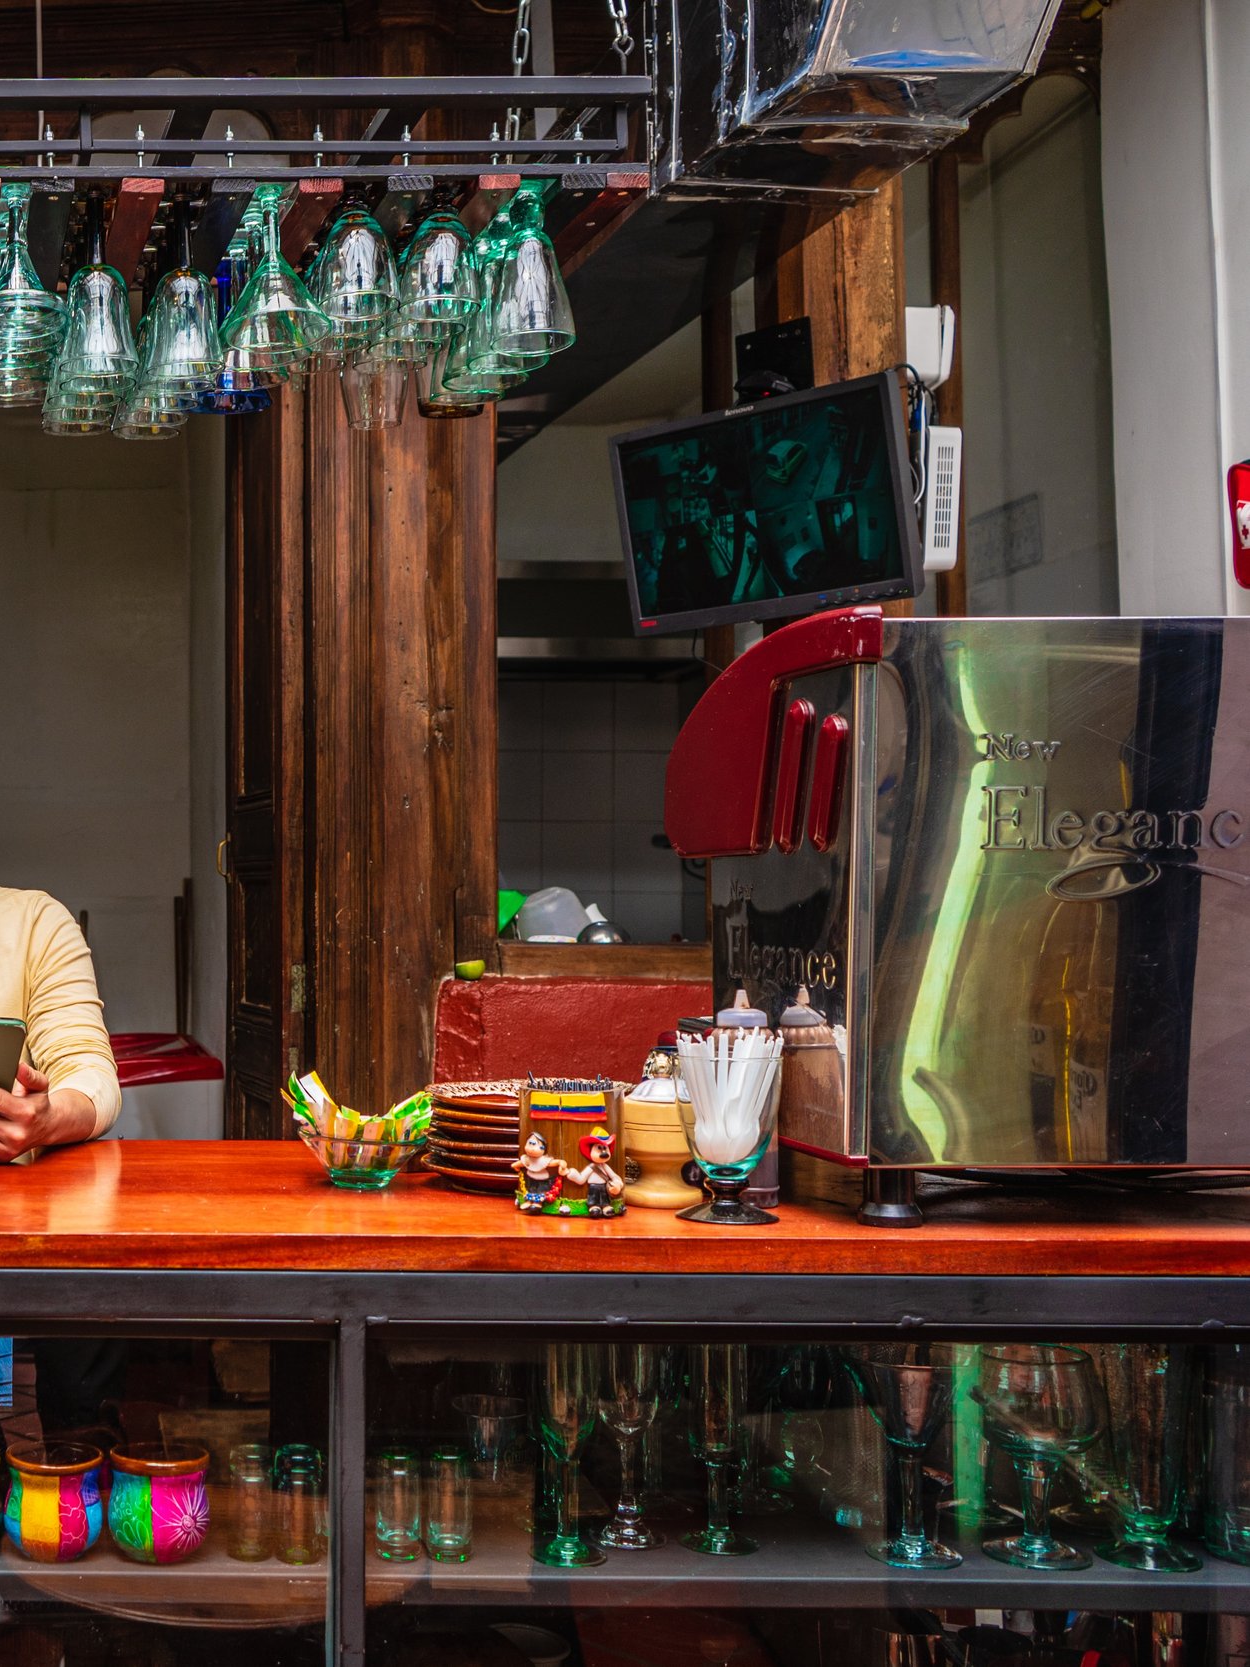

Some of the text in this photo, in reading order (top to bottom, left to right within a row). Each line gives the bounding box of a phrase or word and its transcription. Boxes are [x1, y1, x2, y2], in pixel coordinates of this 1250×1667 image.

[725, 405, 754, 416] lenovo
[981, 732, 1062, 761] New
[726, 922, 837, 990] Elegance
